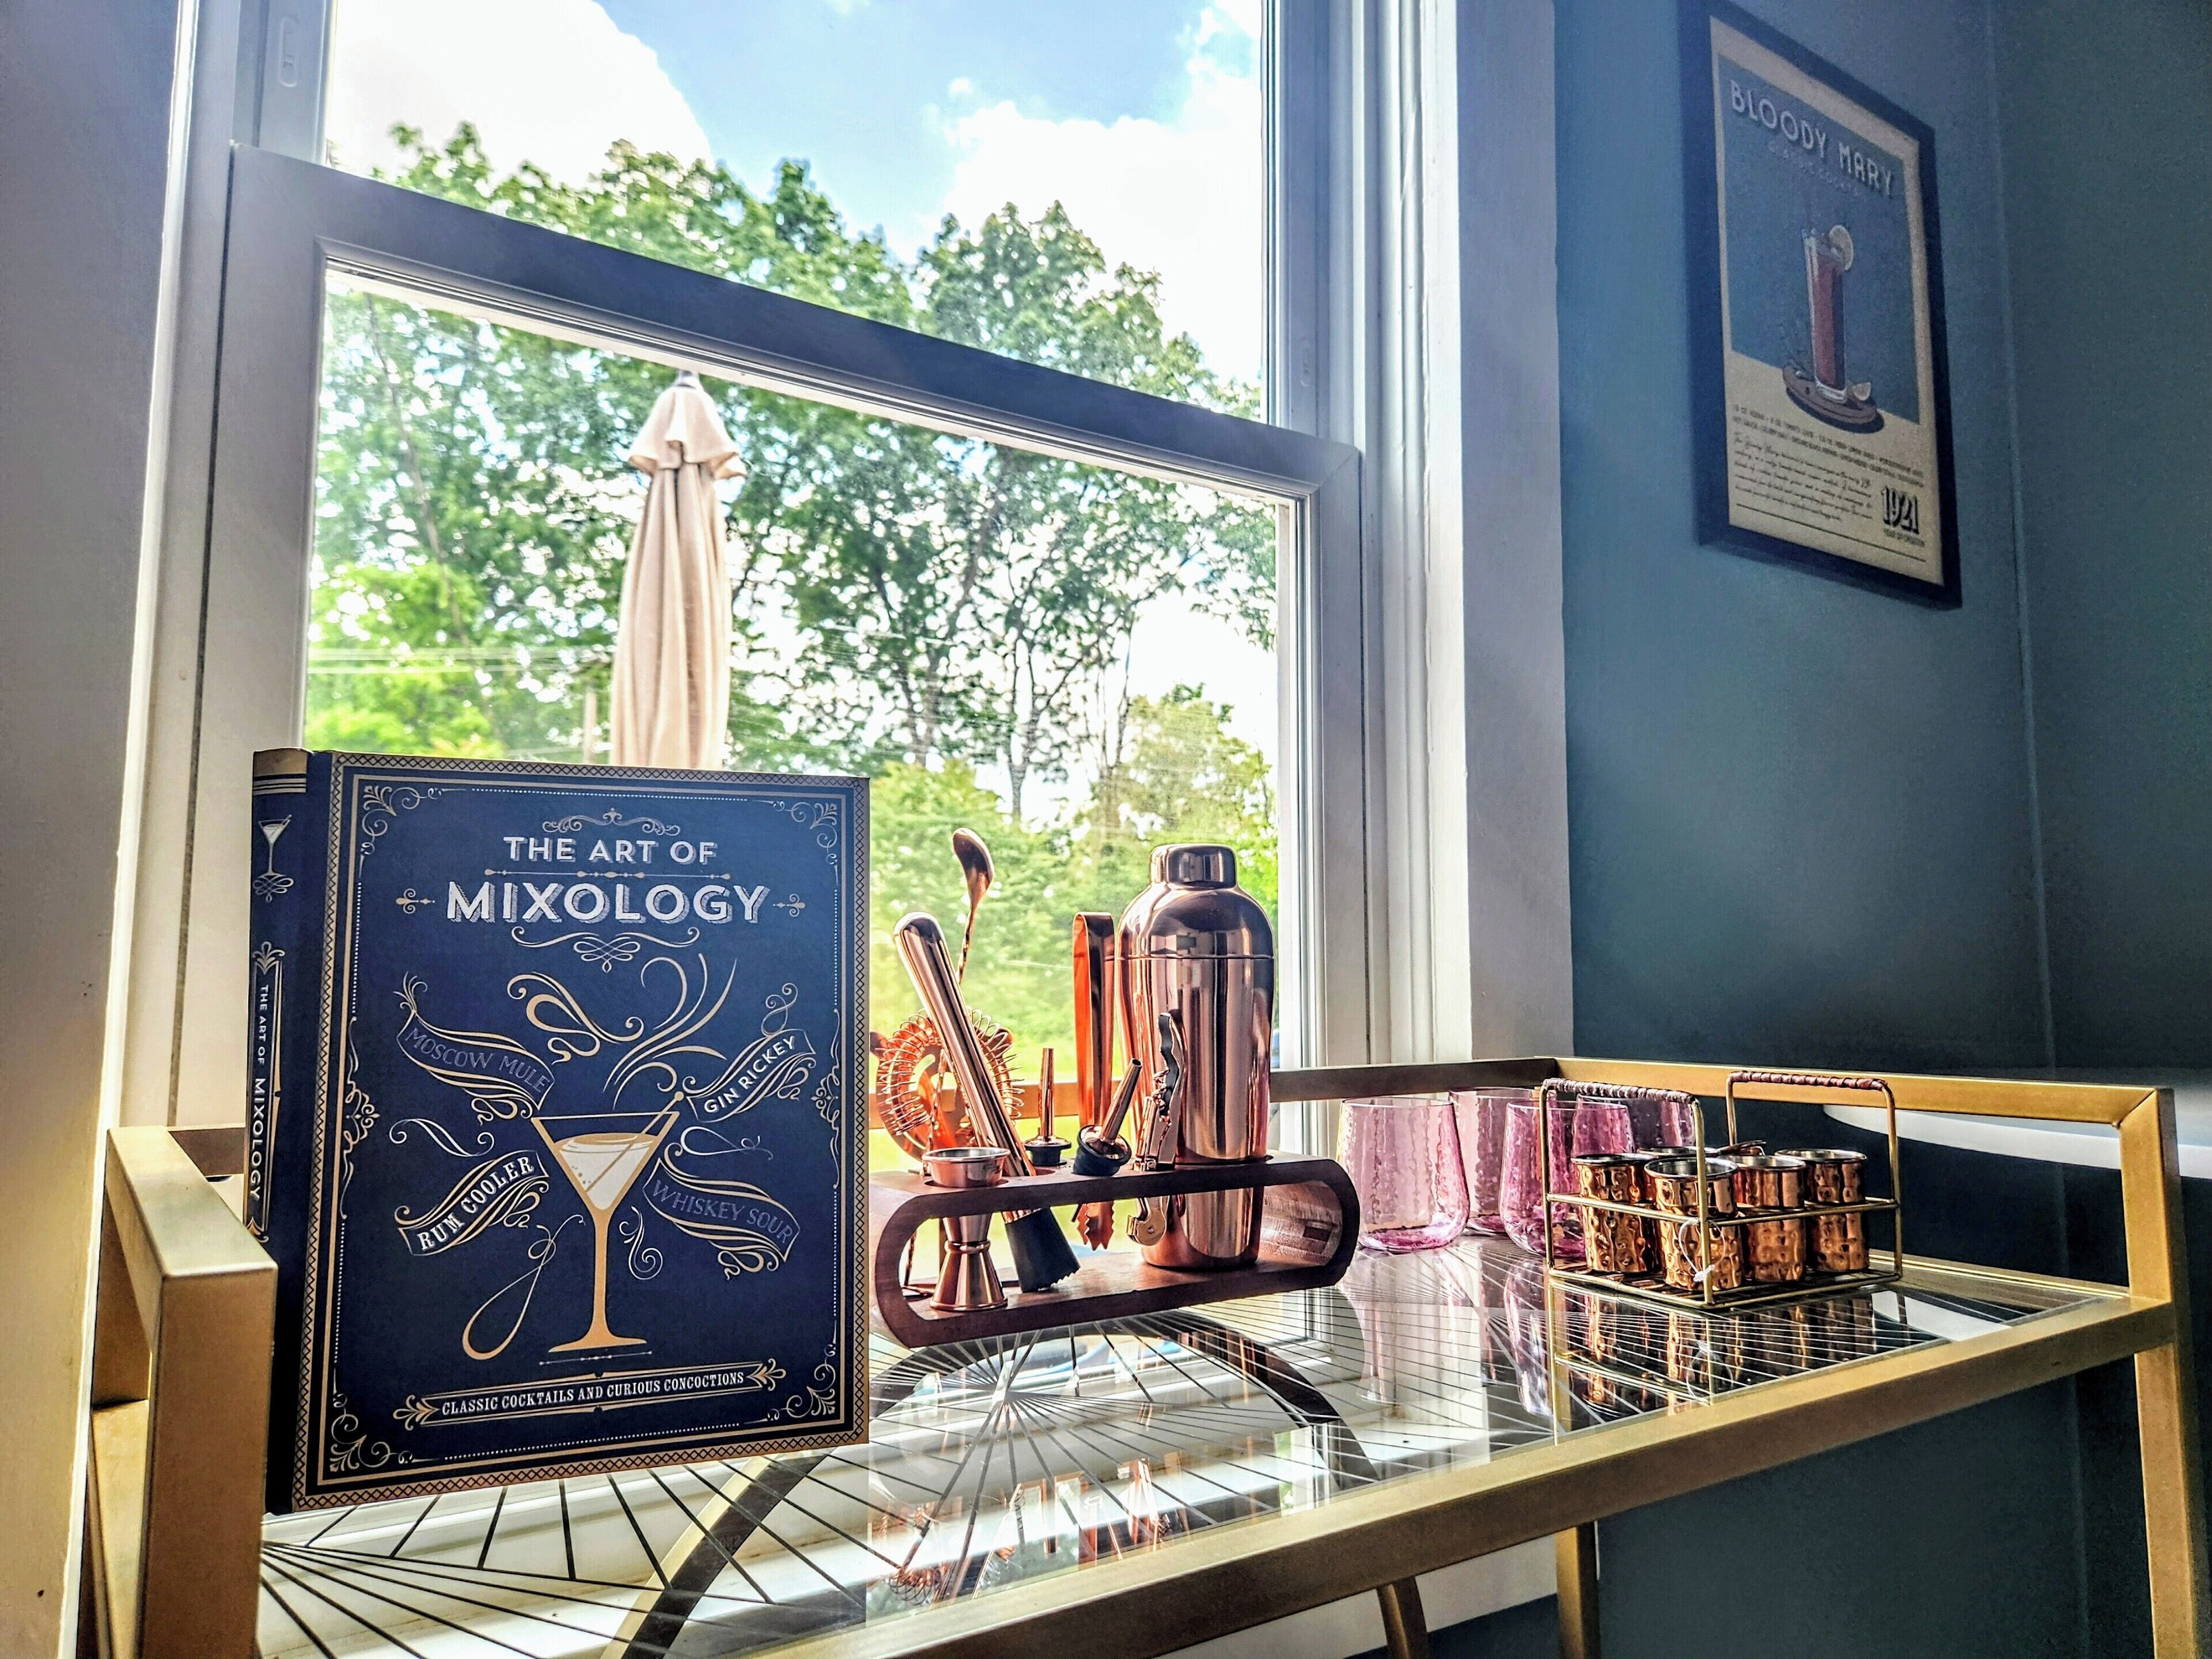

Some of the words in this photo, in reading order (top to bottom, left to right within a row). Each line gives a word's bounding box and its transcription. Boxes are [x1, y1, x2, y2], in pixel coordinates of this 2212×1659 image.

[1730, 79, 1827, 159] BLOODY
[1838, 142, 1893, 197] MARY
[1881, 486, 1920, 535] 1921
[503, 836, 576, 861] THE
[589, 839, 660, 863] ART
[670, 841, 718, 864] OF
[447, 881, 770, 924] MIXOLOGY
[260, 984, 268, 1011] THE
[259, 1017, 267, 1042] ART
[257, 1045, 266, 1066] OF
[405, 1028, 494, 1068] MOSCOW
[499, 1055, 550, 1092] MULE
[704, 1088, 741, 1113] GIN
[738, 1036, 796, 1090] RICKEY
[249, 1078, 266, 1201] MIXOLOGY
[417, 1213, 465, 1251] RUM
[461, 1157, 534, 1214] COOLER
[653, 1180, 745, 1221] WHISKEY
[747, 1209, 793, 1243] SOUR
[442, 1397, 498, 1415] CLASSIC
[501, 1389, 575, 1410] COCKTAILS
[578, 1385, 604, 1400] AND
[607, 1380, 661, 1396] CURIOUS
[663, 1372, 745, 1392] CONCOCTIONS
